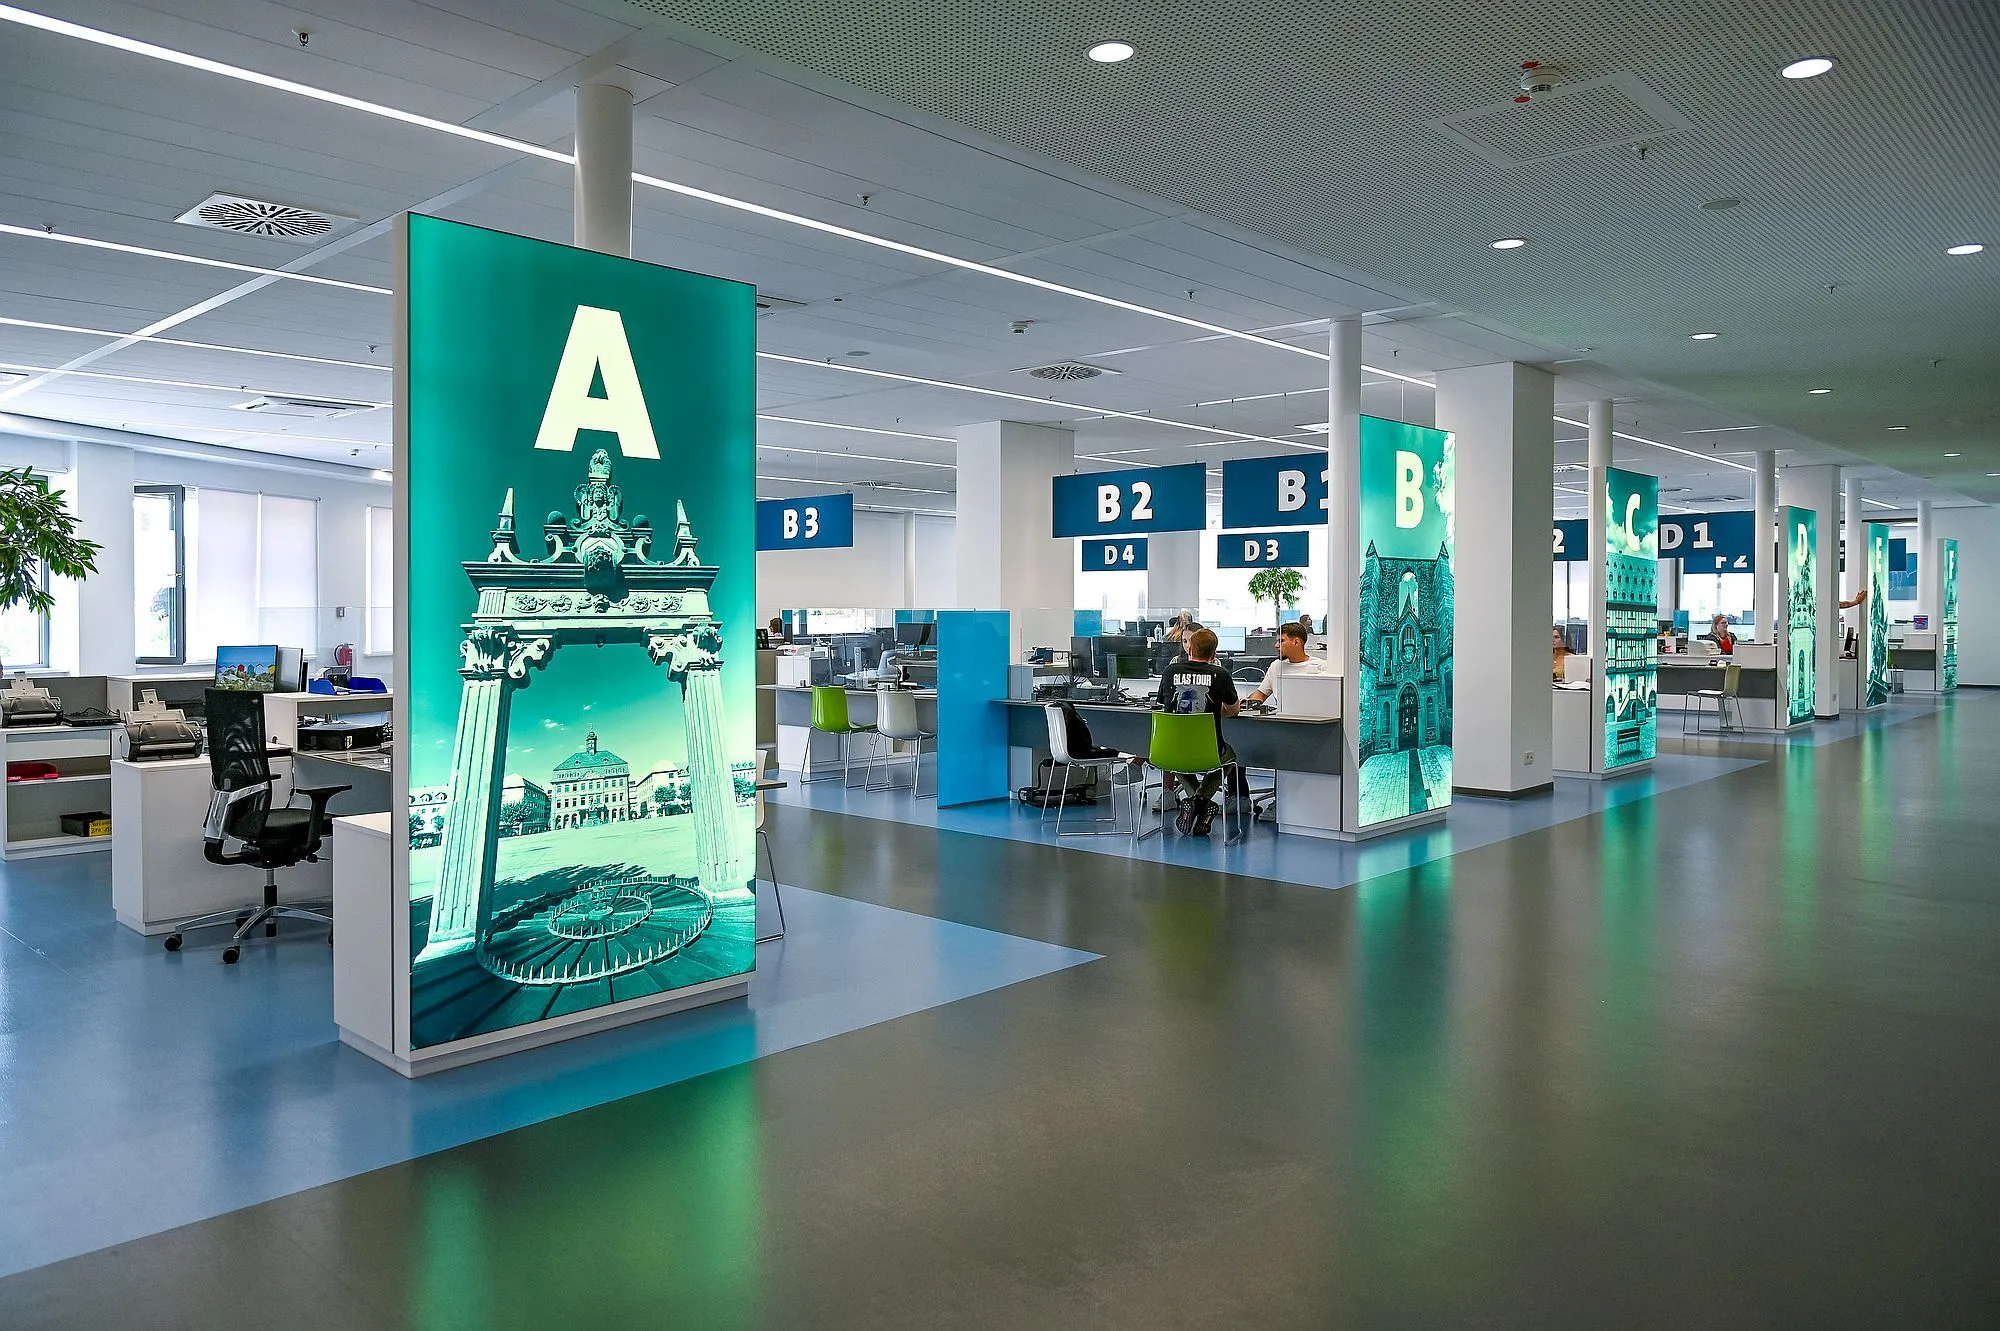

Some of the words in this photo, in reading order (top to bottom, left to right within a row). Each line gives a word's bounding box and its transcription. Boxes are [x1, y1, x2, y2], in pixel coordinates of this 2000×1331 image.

[534, 304, 661, 460] A
[1097, 485, 1121, 523] B
[1131, 481, 1153, 520] 2
[1278, 470, 1306, 512] B
[1395, 451, 1424, 529] B
[783, 509, 799, 540] B
[805, 507, 820, 539] 3
[1625, 493, 1641, 552] C
[1661, 523, 1684, 550] D
[1693, 521, 1714, 549] 1
[1104, 545, 1118, 565] D
[1122, 544, 1135, 564] 4
[1244, 541, 1260, 562] D
[1265, 539, 1280, 561] 3
[1798, 523, 1808, 566] D
[1876, 537, 1882, 573] E
[1949, 550, 1954, 580] F
[1173, 673, 1192, 686] GLAS
[1192, 673, 1212, 686] TOUR
